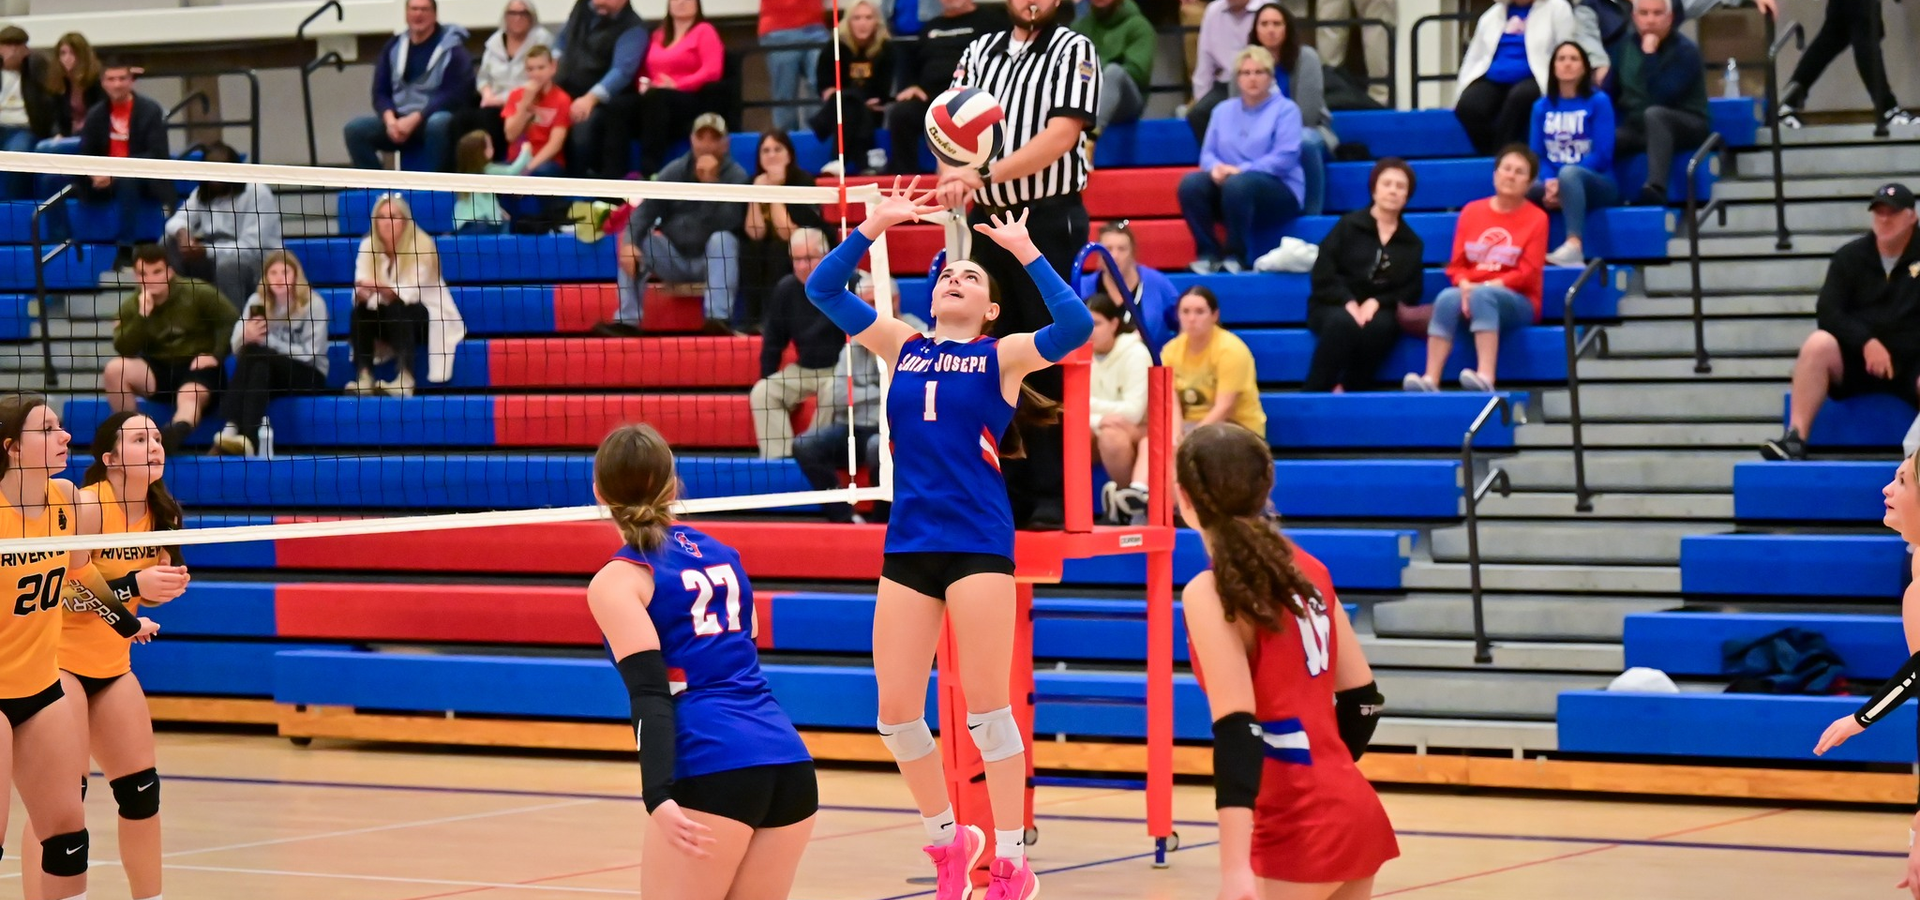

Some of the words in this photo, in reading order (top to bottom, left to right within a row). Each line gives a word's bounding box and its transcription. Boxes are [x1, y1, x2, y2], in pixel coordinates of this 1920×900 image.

[897, 353, 934, 373] SAINT
[934, 353, 988, 373] JOSEPH
[923, 380, 938, 421] 1
[13, 566, 66, 617] 20
[680, 563, 741, 637] 27
